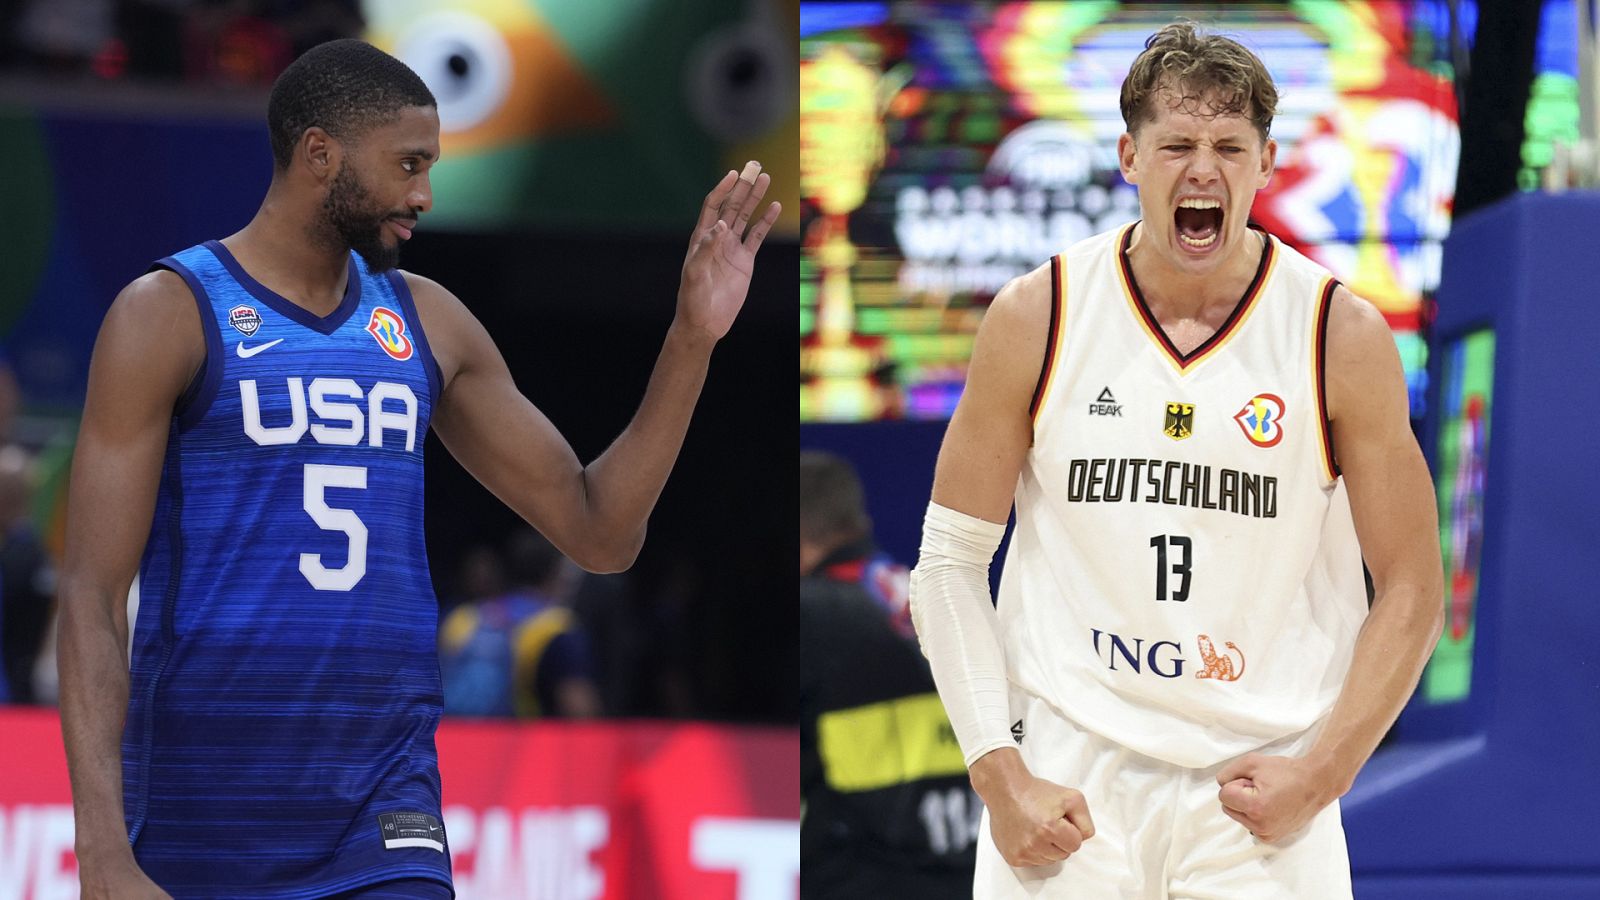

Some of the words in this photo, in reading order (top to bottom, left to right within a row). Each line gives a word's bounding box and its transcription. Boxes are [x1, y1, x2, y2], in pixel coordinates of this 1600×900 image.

[239, 377, 418, 452] USA
[1088, 403, 1124, 417] PEAK
[1067, 458, 1278, 518] DEUTSCHLAND
[298, 464, 369, 591] 5
[1150, 534, 1193, 602] 13
[1090, 628, 1186, 678] ING
[384, 822, 395, 831] 48
